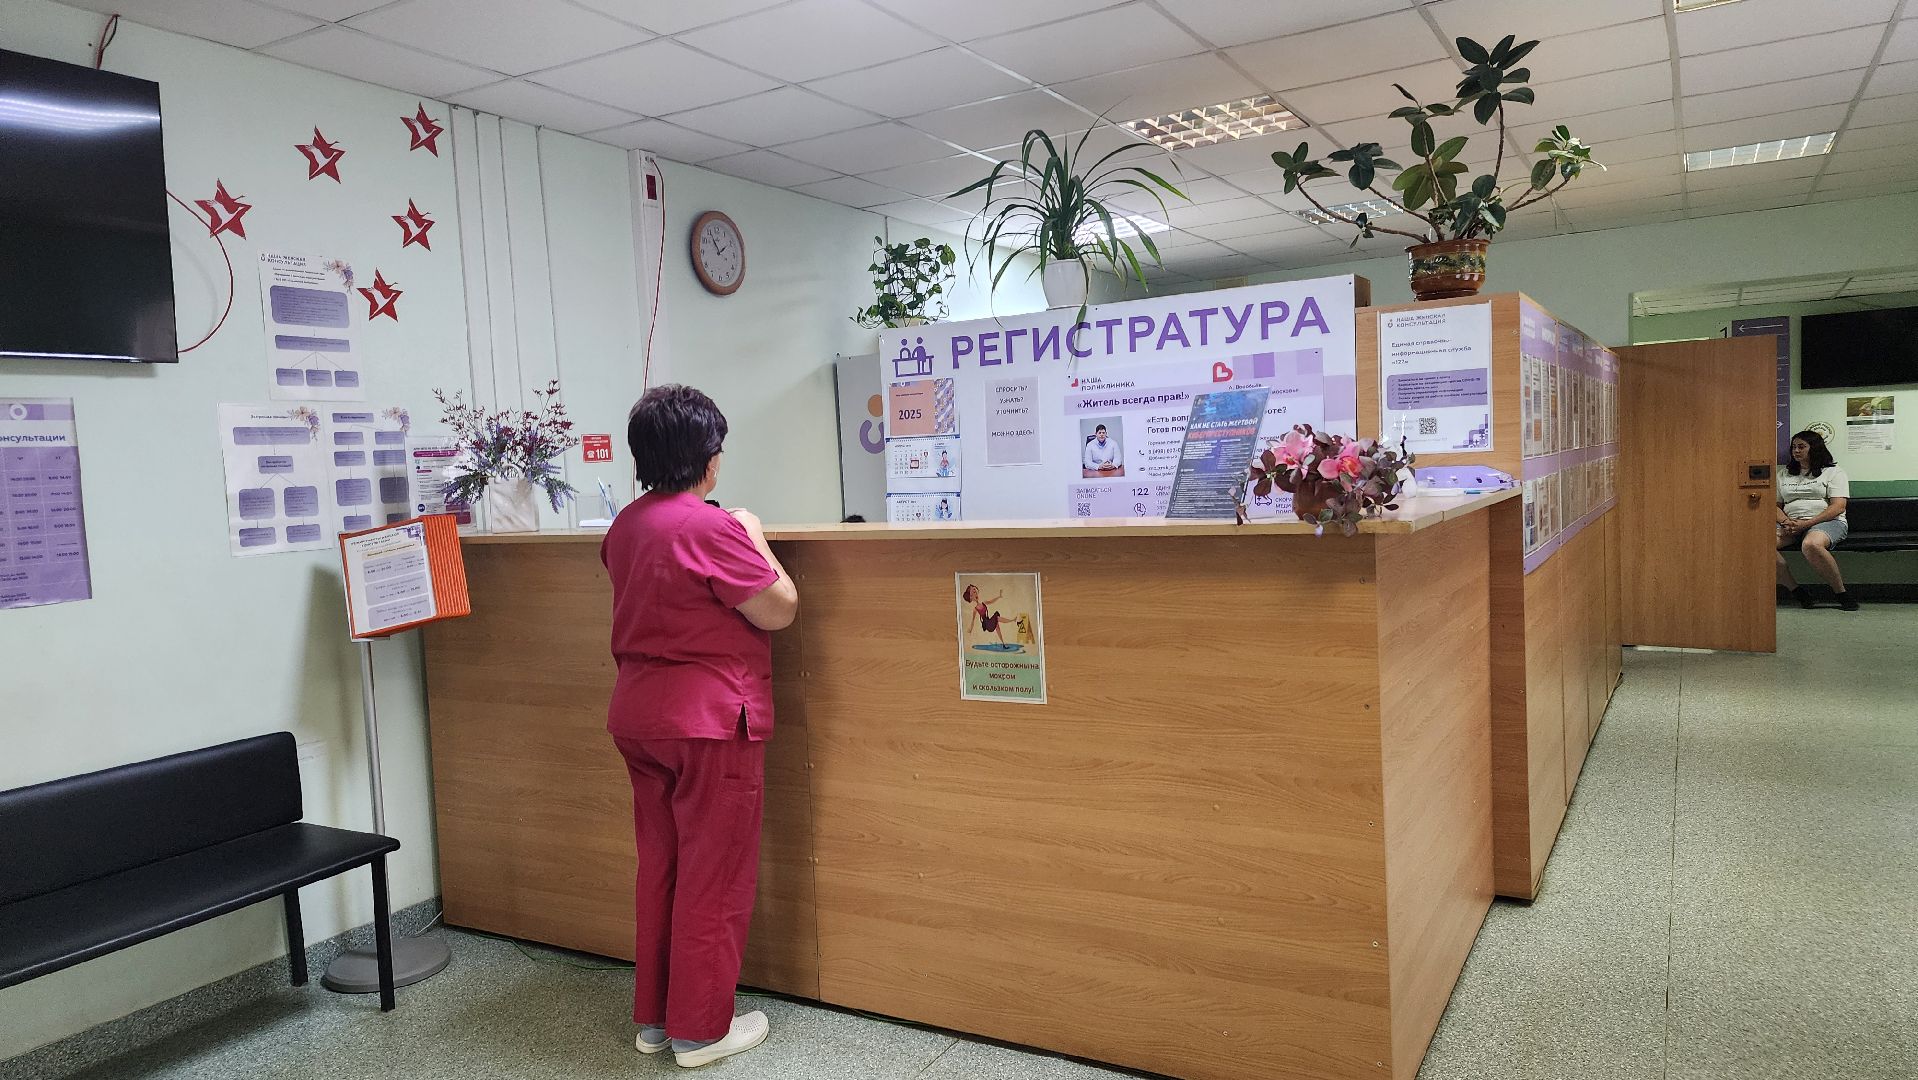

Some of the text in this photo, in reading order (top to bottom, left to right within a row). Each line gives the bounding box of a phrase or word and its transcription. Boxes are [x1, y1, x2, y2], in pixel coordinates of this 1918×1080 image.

[952, 296, 1331, 369] РЕГИСТРАТУРА
[1447, 346, 1472, 354] служба
[1081, 377, 1102, 385] НАША
[1081, 381, 1135, 392] ПОЛИКЛИНИКА
[1077, 391, 1190, 409] «Житель всегда прав!»
[898, 409, 922, 420] 2025
[1146, 416, 1170, 424] «Есть
[1147, 426, 1170, 434] Готов
[596, 448, 609, 459] 101
[1132, 488, 1149, 497] 122
[965, 660, 989, 669] Будьте
[990, 661, 1030, 670] осторожны
[978, 684, 1015, 692] скользком
[1015, 684, 1035, 694] полу!
